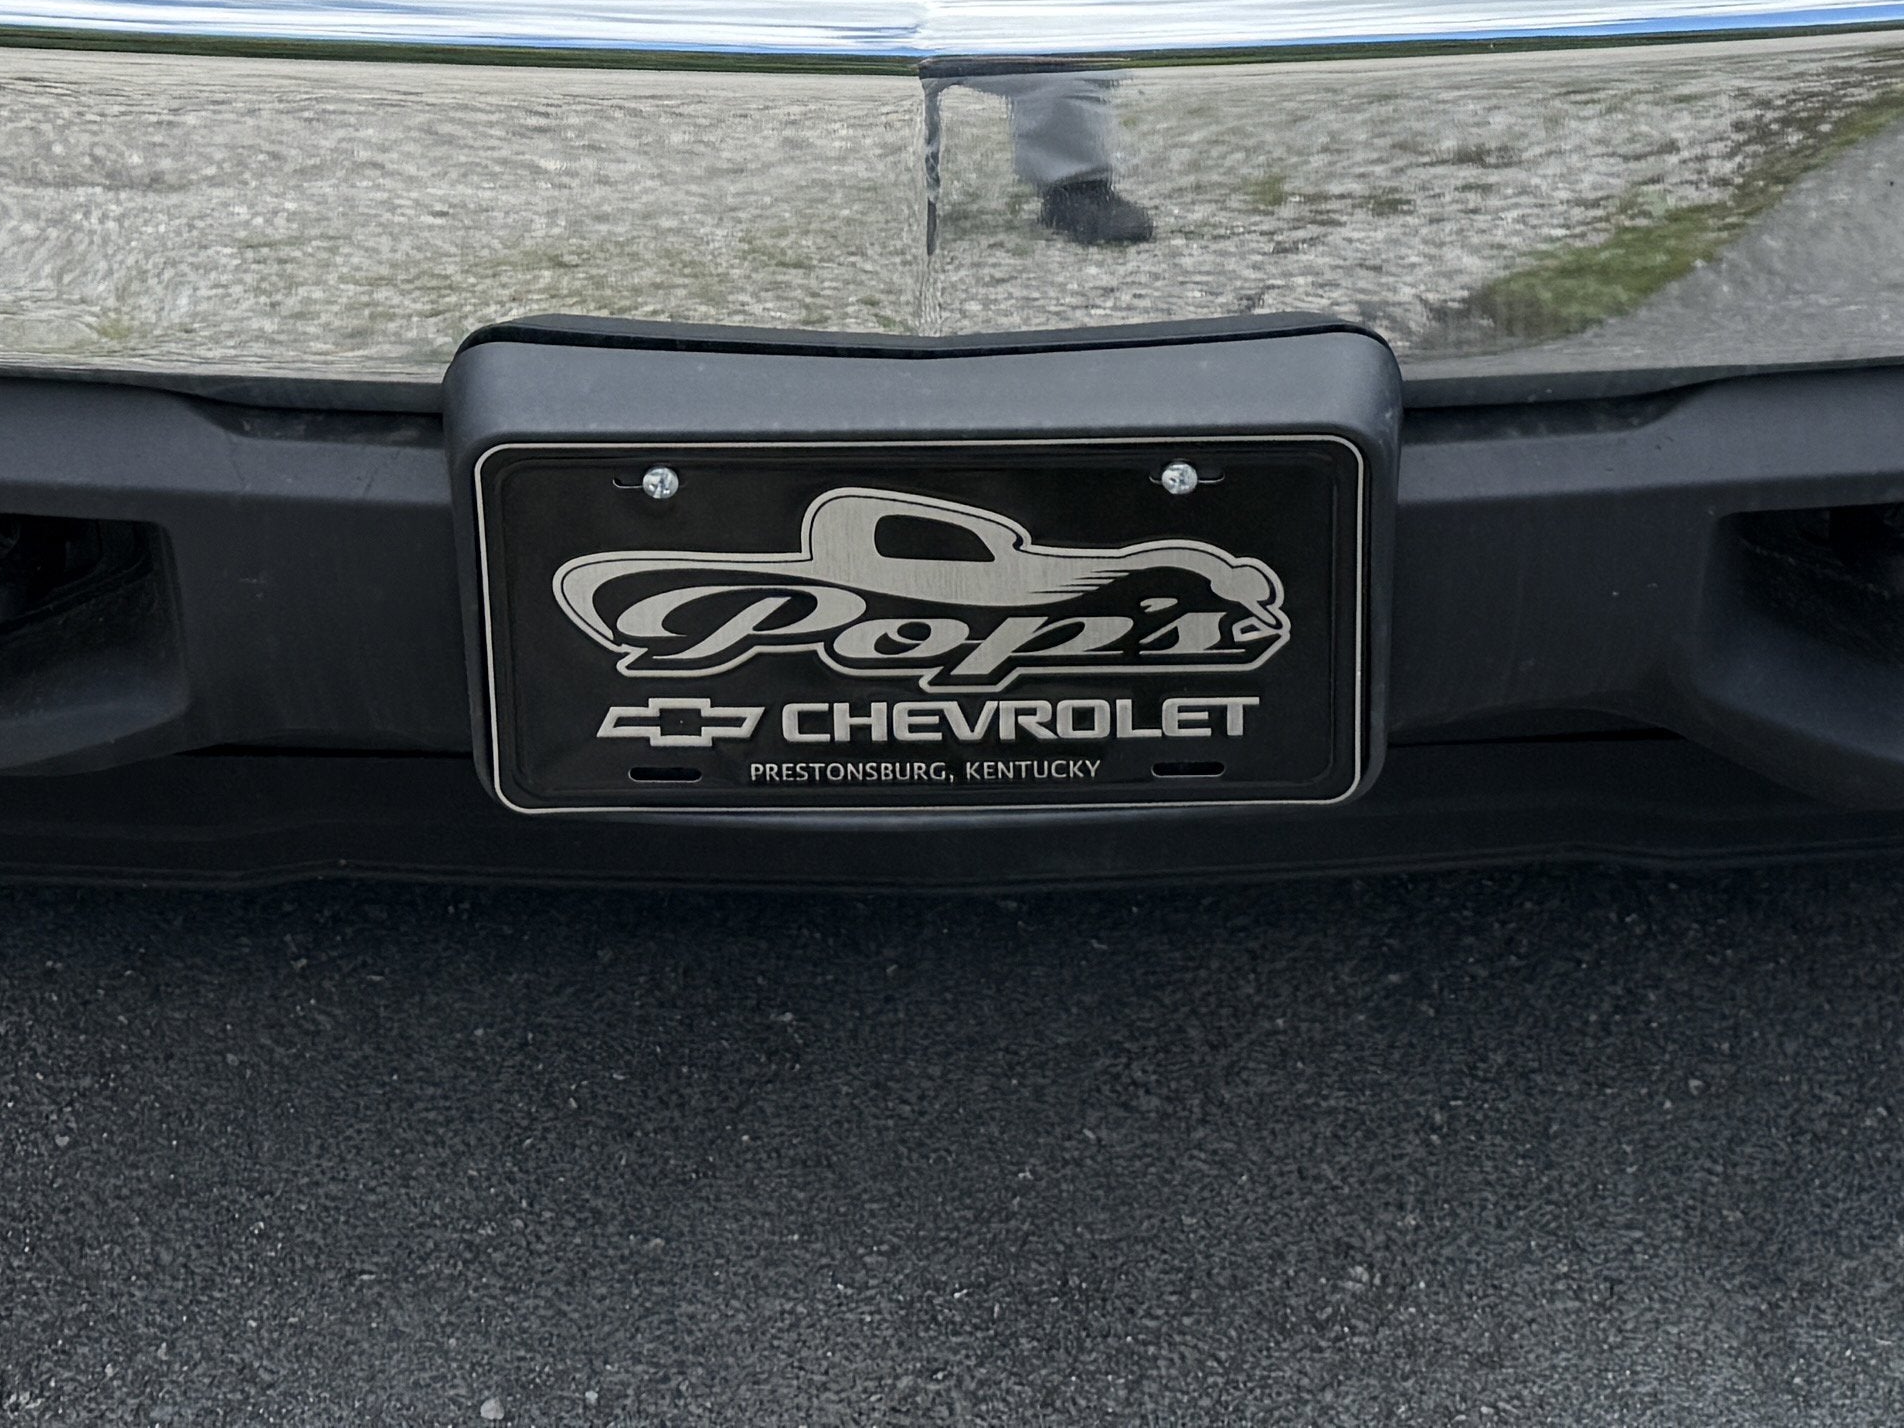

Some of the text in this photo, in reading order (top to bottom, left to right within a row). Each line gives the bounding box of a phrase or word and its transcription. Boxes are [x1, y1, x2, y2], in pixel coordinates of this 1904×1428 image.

[614, 584, 1242, 676] Pop's
[781, 696, 1260, 743] CHEVROLET
[750, 759, 1101, 783] PRESTONSBURG, KENTUCKY
